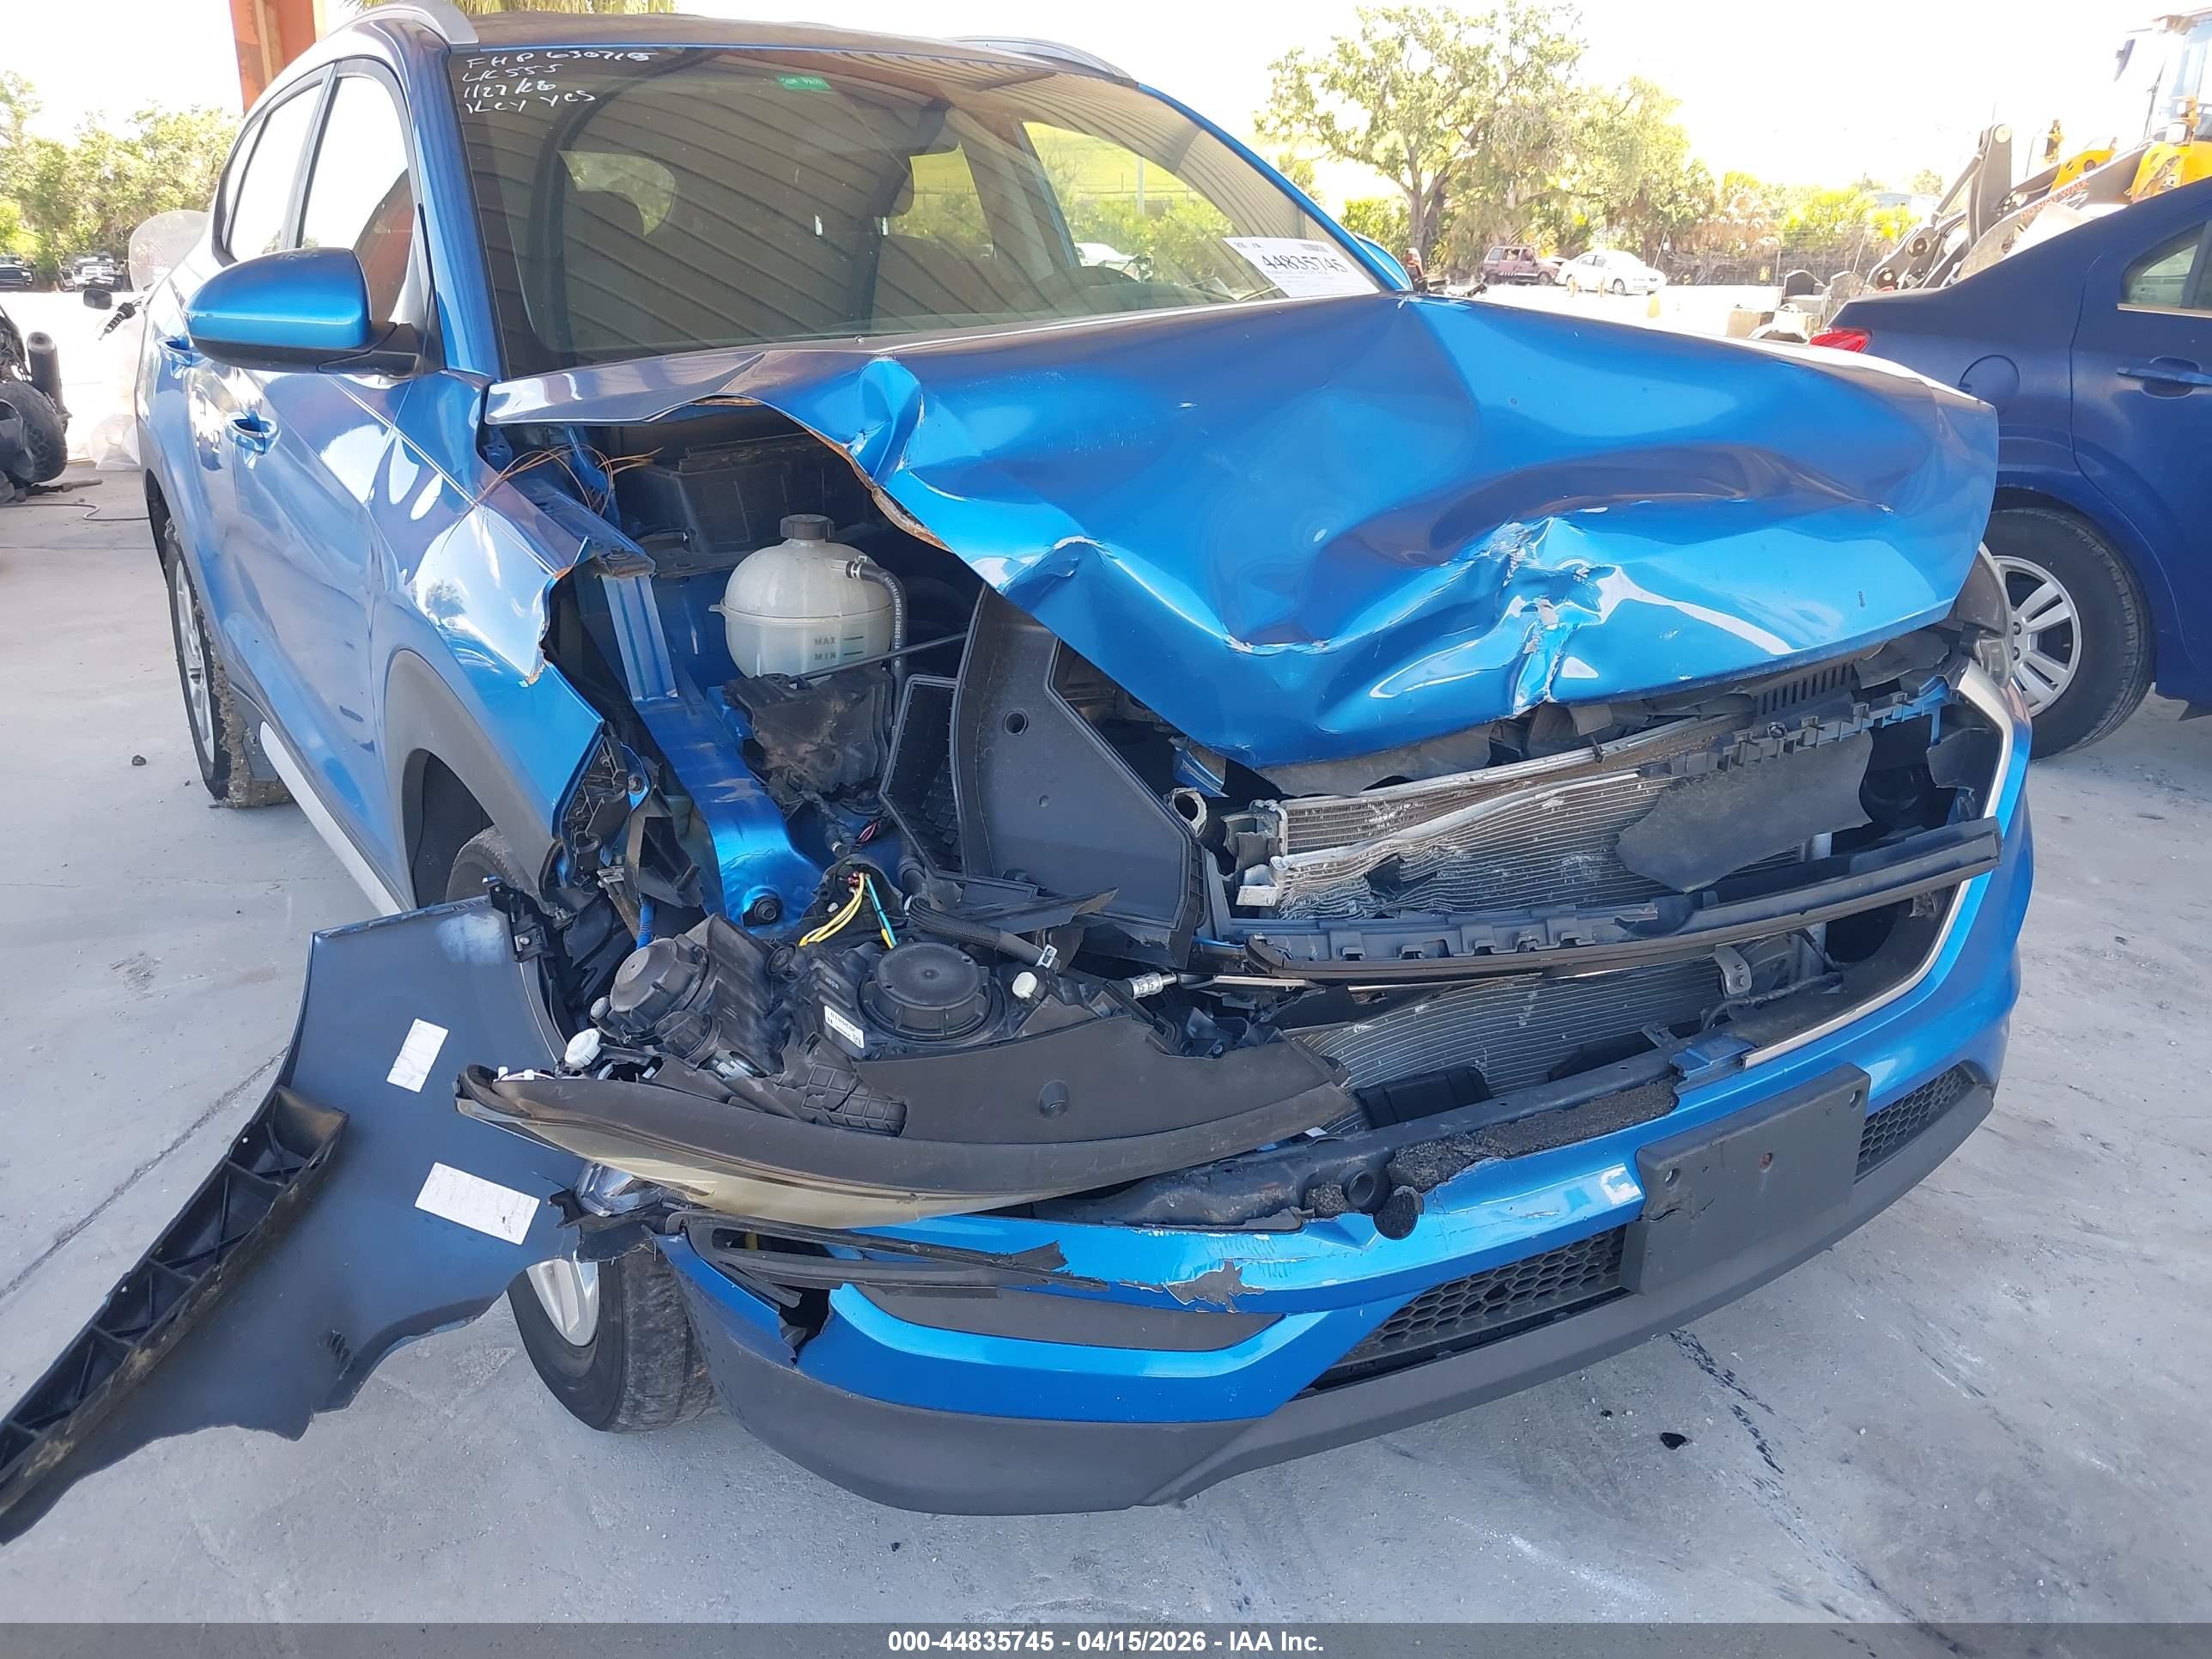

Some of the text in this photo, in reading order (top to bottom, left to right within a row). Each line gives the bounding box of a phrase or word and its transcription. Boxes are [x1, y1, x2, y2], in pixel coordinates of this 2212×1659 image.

[1261, 254, 1348, 273] 44835745
[814, 635, 836, 646] MAX
[814, 652, 836, 660] MIN
